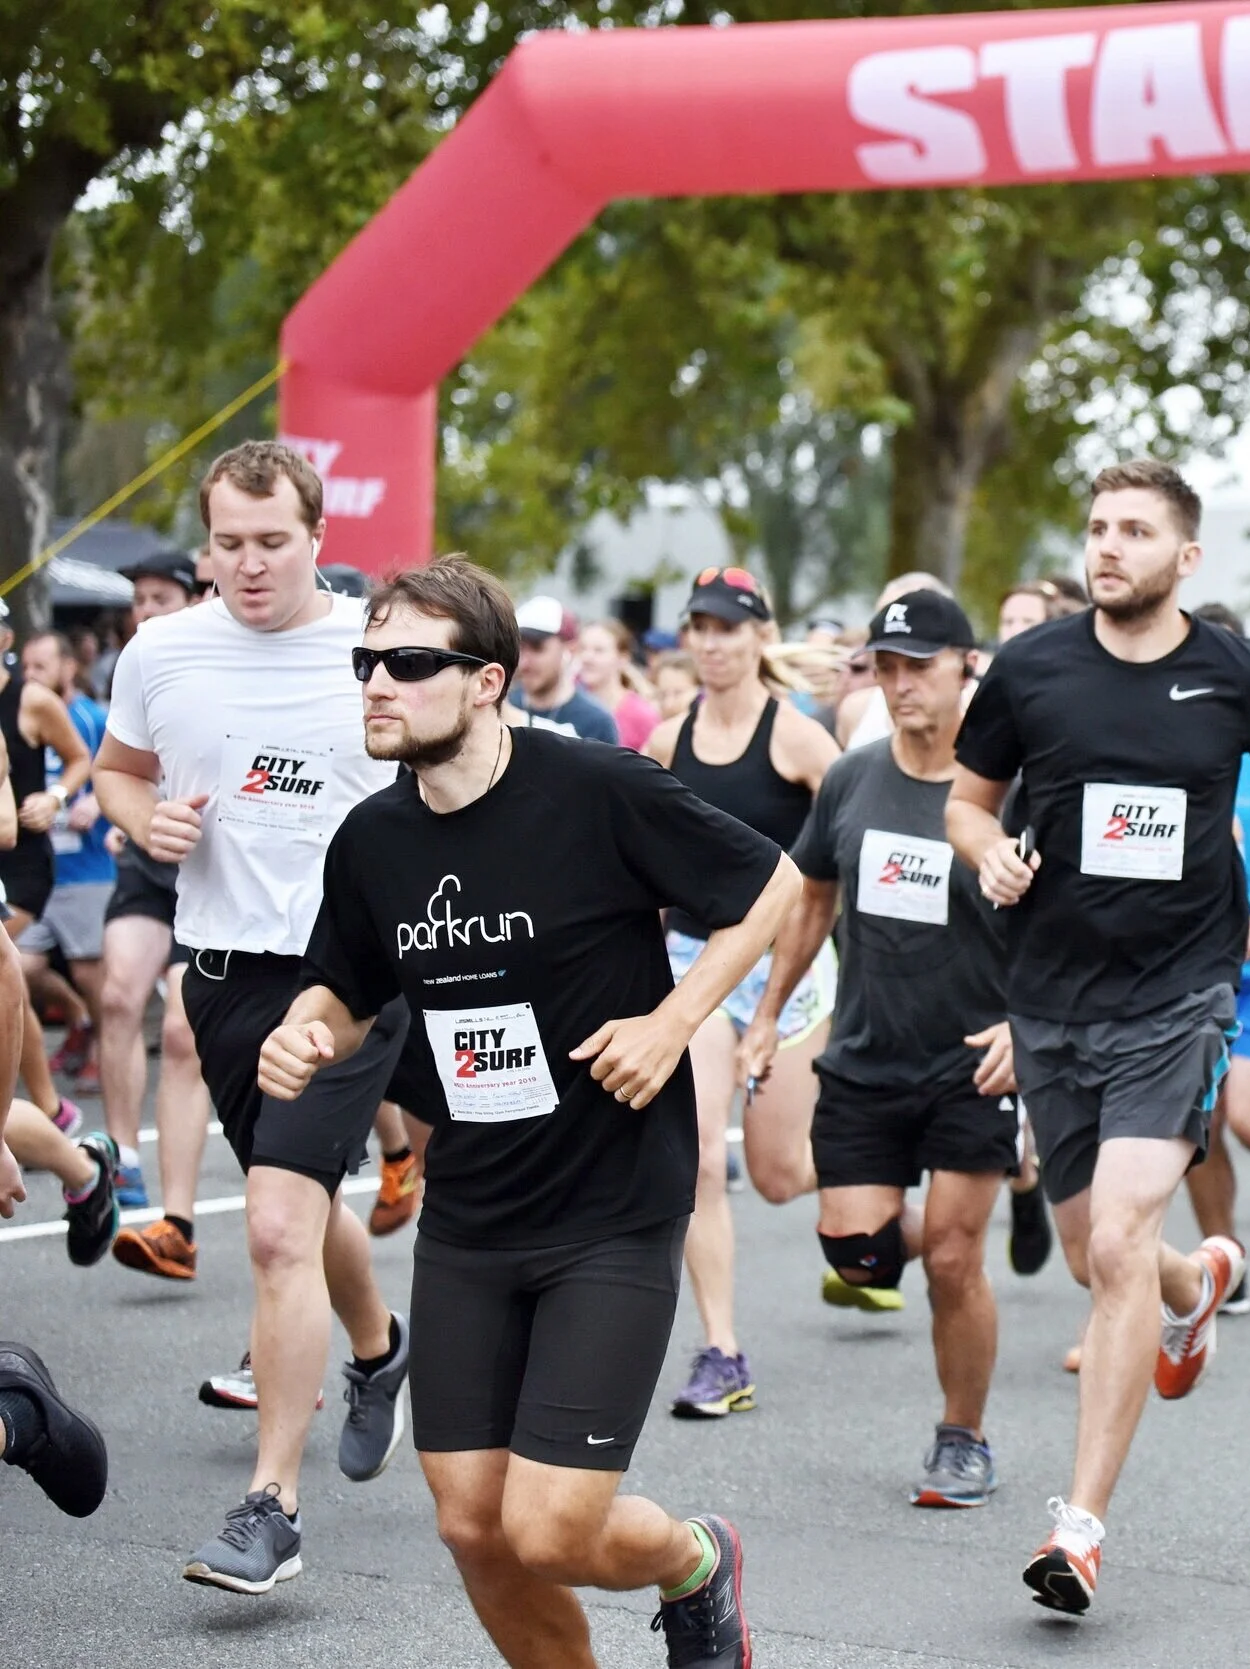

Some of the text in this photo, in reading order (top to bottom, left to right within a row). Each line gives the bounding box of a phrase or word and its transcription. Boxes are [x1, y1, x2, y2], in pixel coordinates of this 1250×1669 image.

[251, 755, 306, 775] CITY
[1112, 803, 1160, 820] CITY
[888, 852, 928, 868] CITY
[397, 874, 534, 959] parkrun
[435, 974, 462, 985] zealand
[479, 972, 498, 980] LOANS
[454, 1028, 506, 1052] CITY
[466, 1081, 500, 1089] Anniversary
[502, 1080, 516, 1088] year
[518, 1076, 537, 1085] 2019
